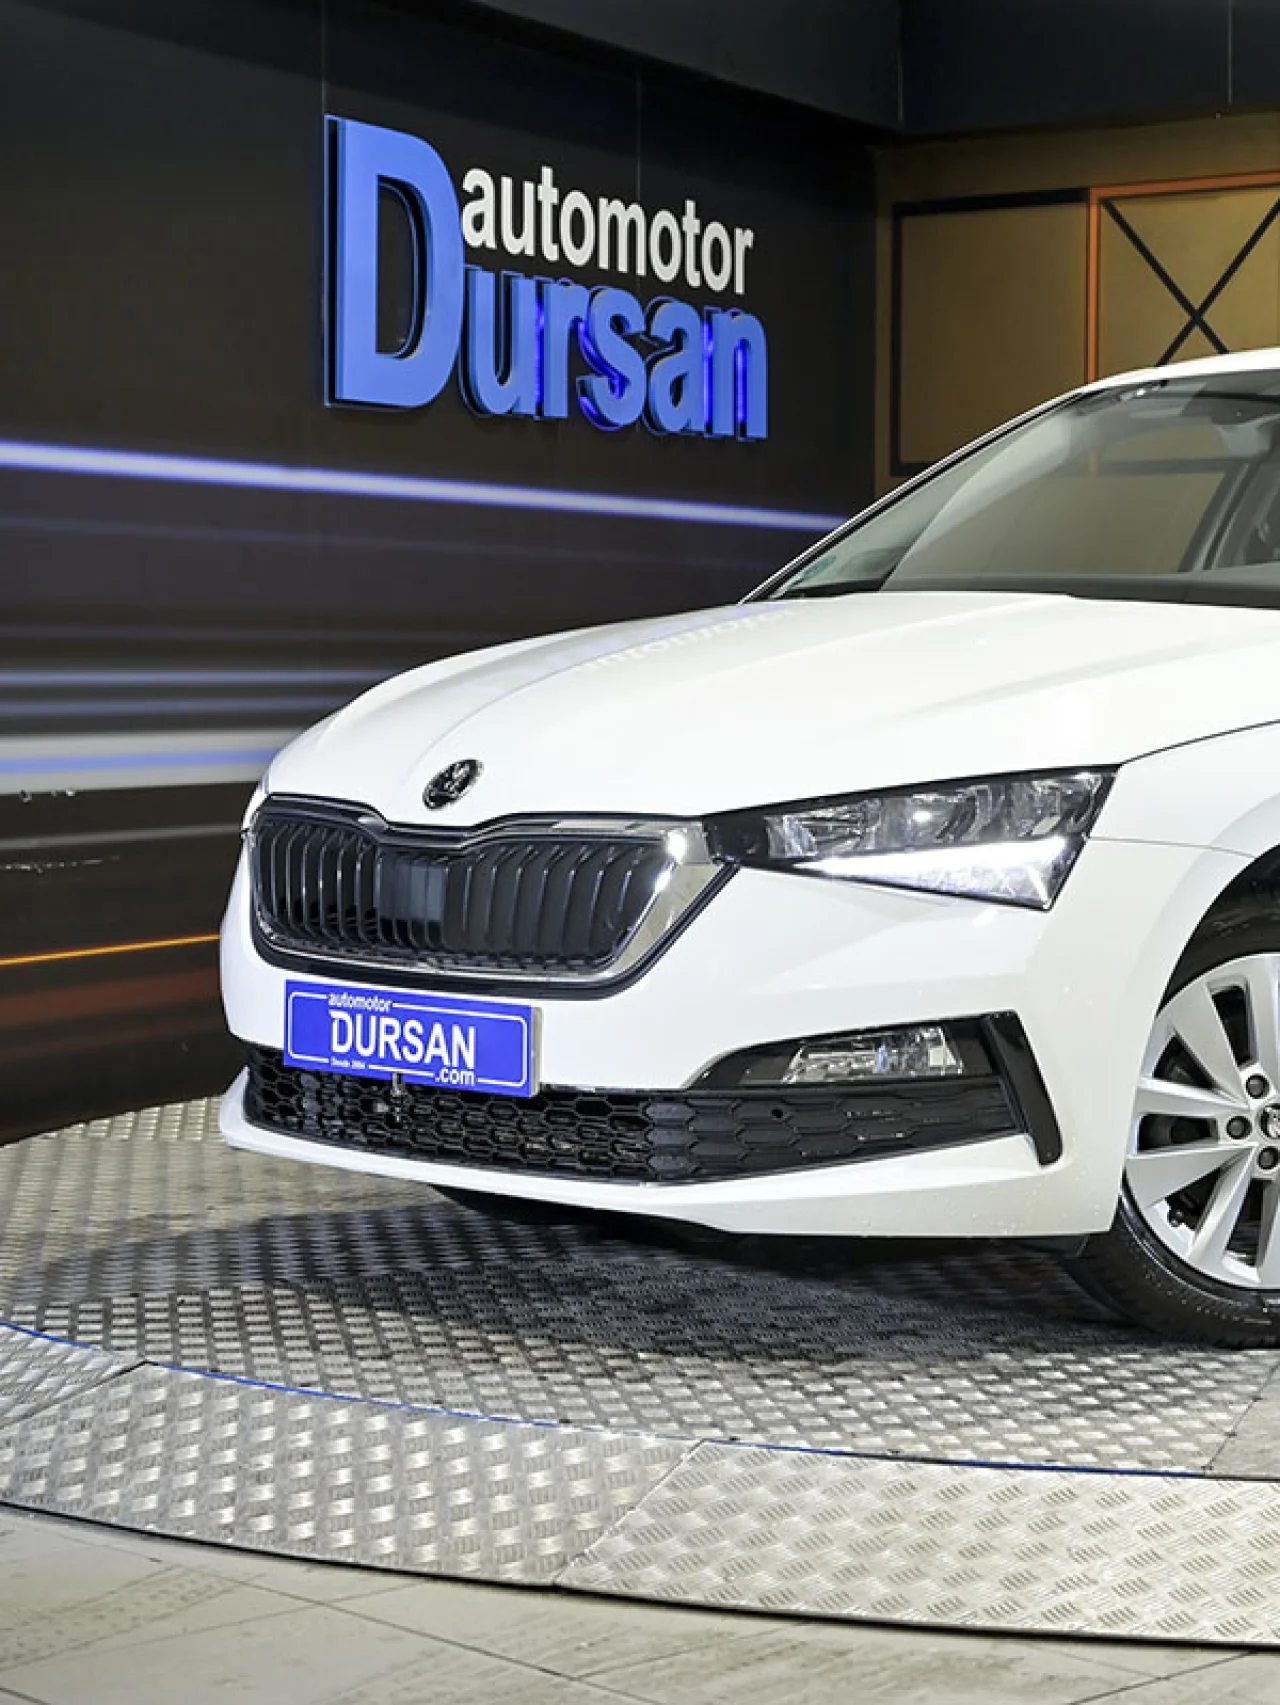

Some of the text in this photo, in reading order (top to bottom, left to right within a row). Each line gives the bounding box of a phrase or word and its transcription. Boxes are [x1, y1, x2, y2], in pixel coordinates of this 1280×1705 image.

[462, 166, 754, 294] automotor
[324, 114, 768, 441] Dursan
[328, 992, 392, 1012] automotor
[328, 1008, 476, 1069] DURSAN
[435, 1067, 476, 1086] .com
